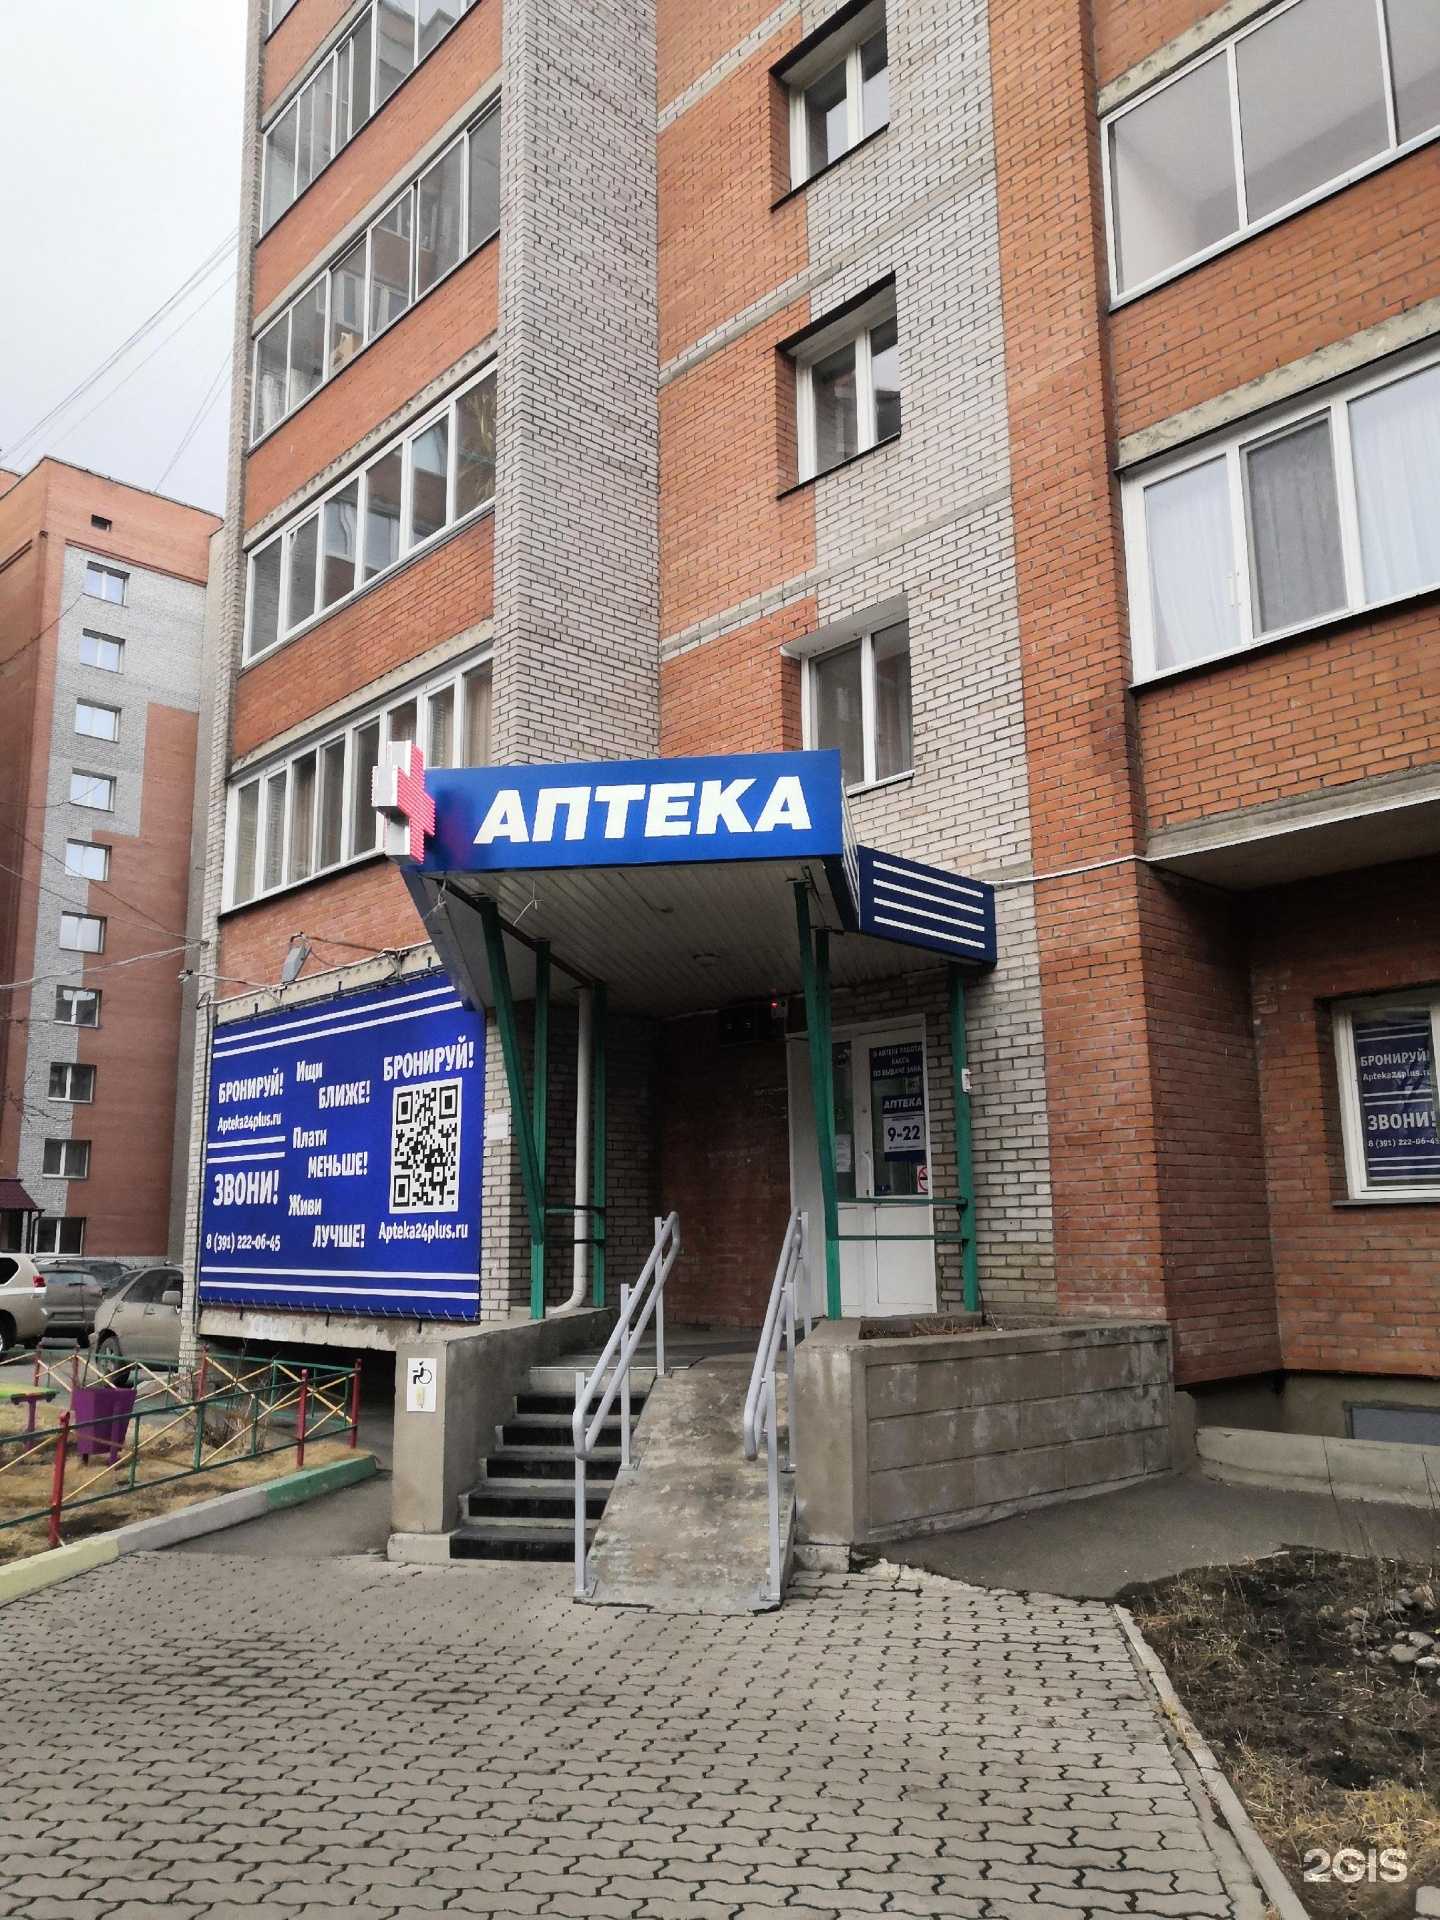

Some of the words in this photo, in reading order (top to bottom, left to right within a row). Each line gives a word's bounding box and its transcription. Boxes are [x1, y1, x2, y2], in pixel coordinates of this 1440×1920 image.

[473, 775, 812, 844] АПТЕКА
[382, 1034, 474, 1081] БРОНИРУЙ!
[296, 1060, 323, 1084] Ищи
[218, 1067, 284, 1104] БРОНИРУЙ!
[318, 1080, 370, 1109] БЛИЖЕ!
[883, 1097, 922, 1110] АПТЕКА
[217, 1111, 281, 1135] Apteka24plus.ru
[1367, 1110, 1436, 1130] ЗВОНИ!
[292, 1127, 327, 1149] Плати
[887, 1125, 920, 1141] 9-22
[307, 1151, 368, 1178] МЕНЬШЕ!
[212, 1169, 280, 1206] ЗВОНИ!
[288, 1193, 322, 1216] Живи
[206, 1233, 212, 1250] 8
[213, 1232, 236, 1254] (391)
[237, 1233, 281, 1252] 222-06-45
[312, 1223, 366, 1249] ЛУЧШЕ!
[378, 1219, 469, 1244] Apteka24plus.ru
